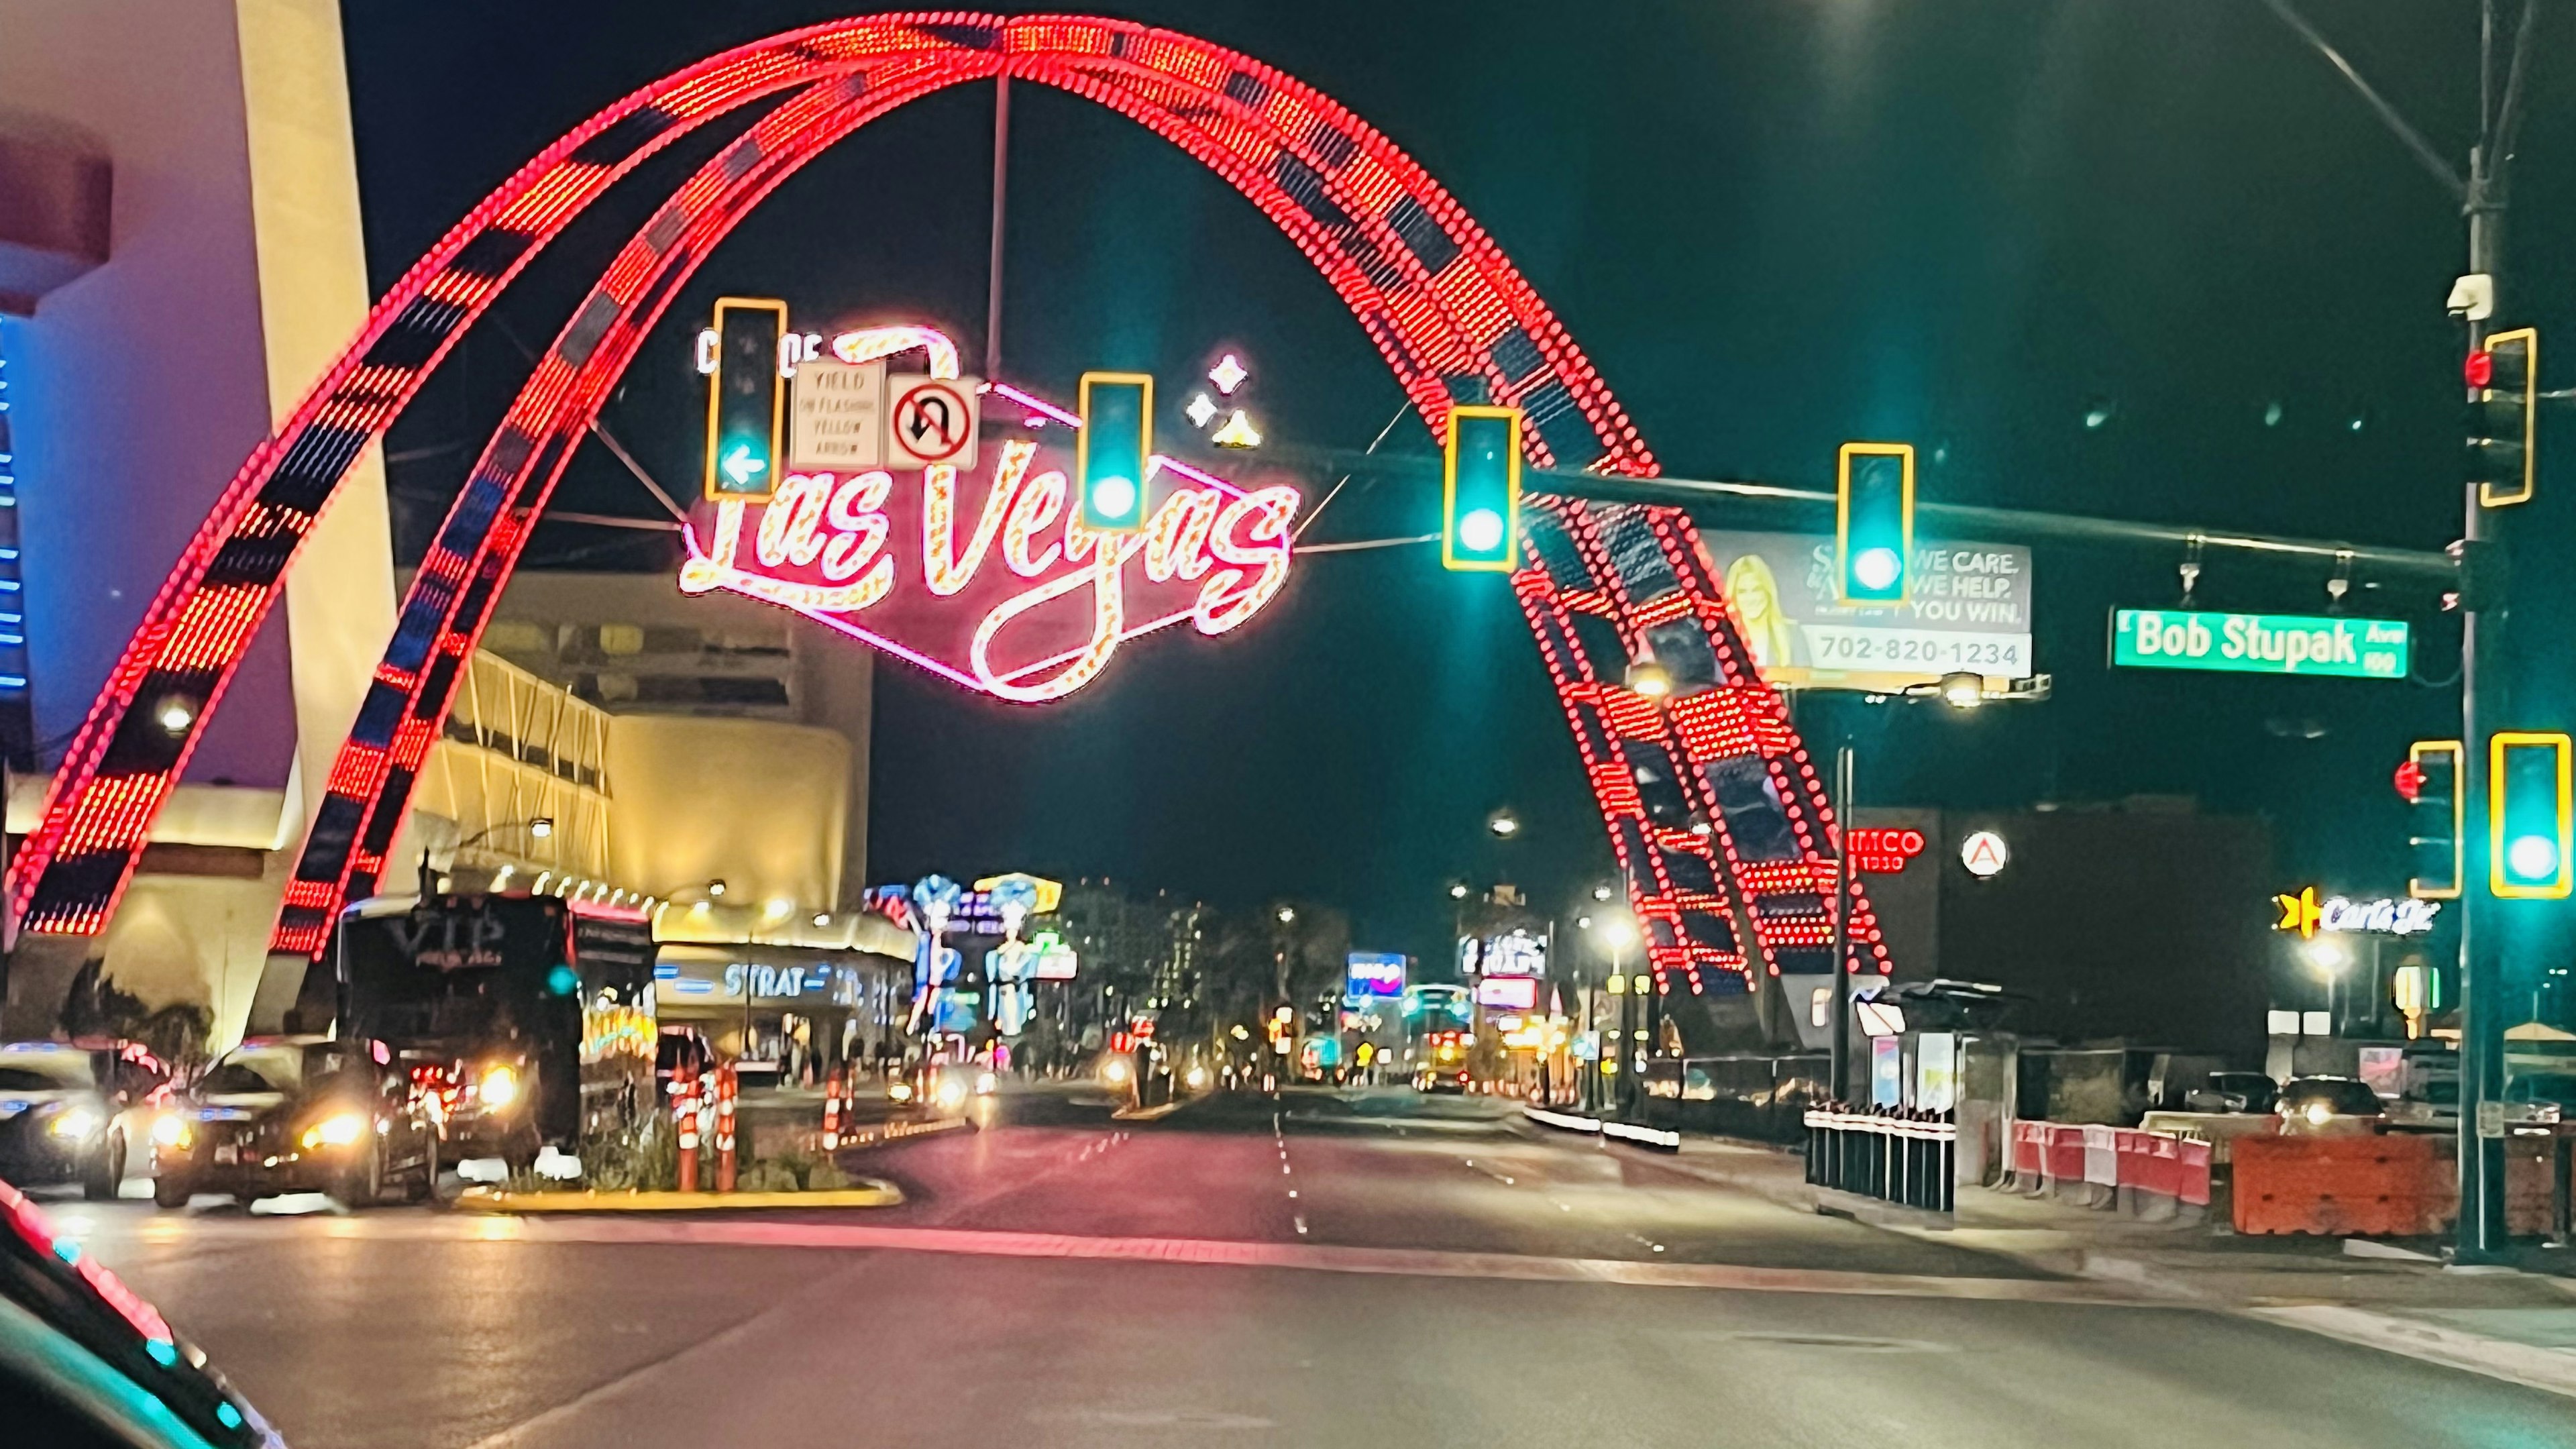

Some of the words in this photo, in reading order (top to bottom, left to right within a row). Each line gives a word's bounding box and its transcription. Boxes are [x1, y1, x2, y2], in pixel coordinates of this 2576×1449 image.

[814, 370, 865, 390] YIELD
[678, 470, 897, 613] Las
[833, 325, 1303, 704] Vegas
[1913, 549, 1948, 572] WE
[1951, 551, 2020, 575] CARE.
[1913, 574, 1948, 596] WE
[1951, 577, 2012, 600] HELP.
[1911, 600, 1961, 621] YOU
[1966, 602, 2022, 625] WIN.
[1820, 637, 2018, 665] 702-820-1234
[2136, 613, 2212, 657] Bob
[2220, 617, 2357, 673] Stupak
[725, 963, 806, 998] STRAT
